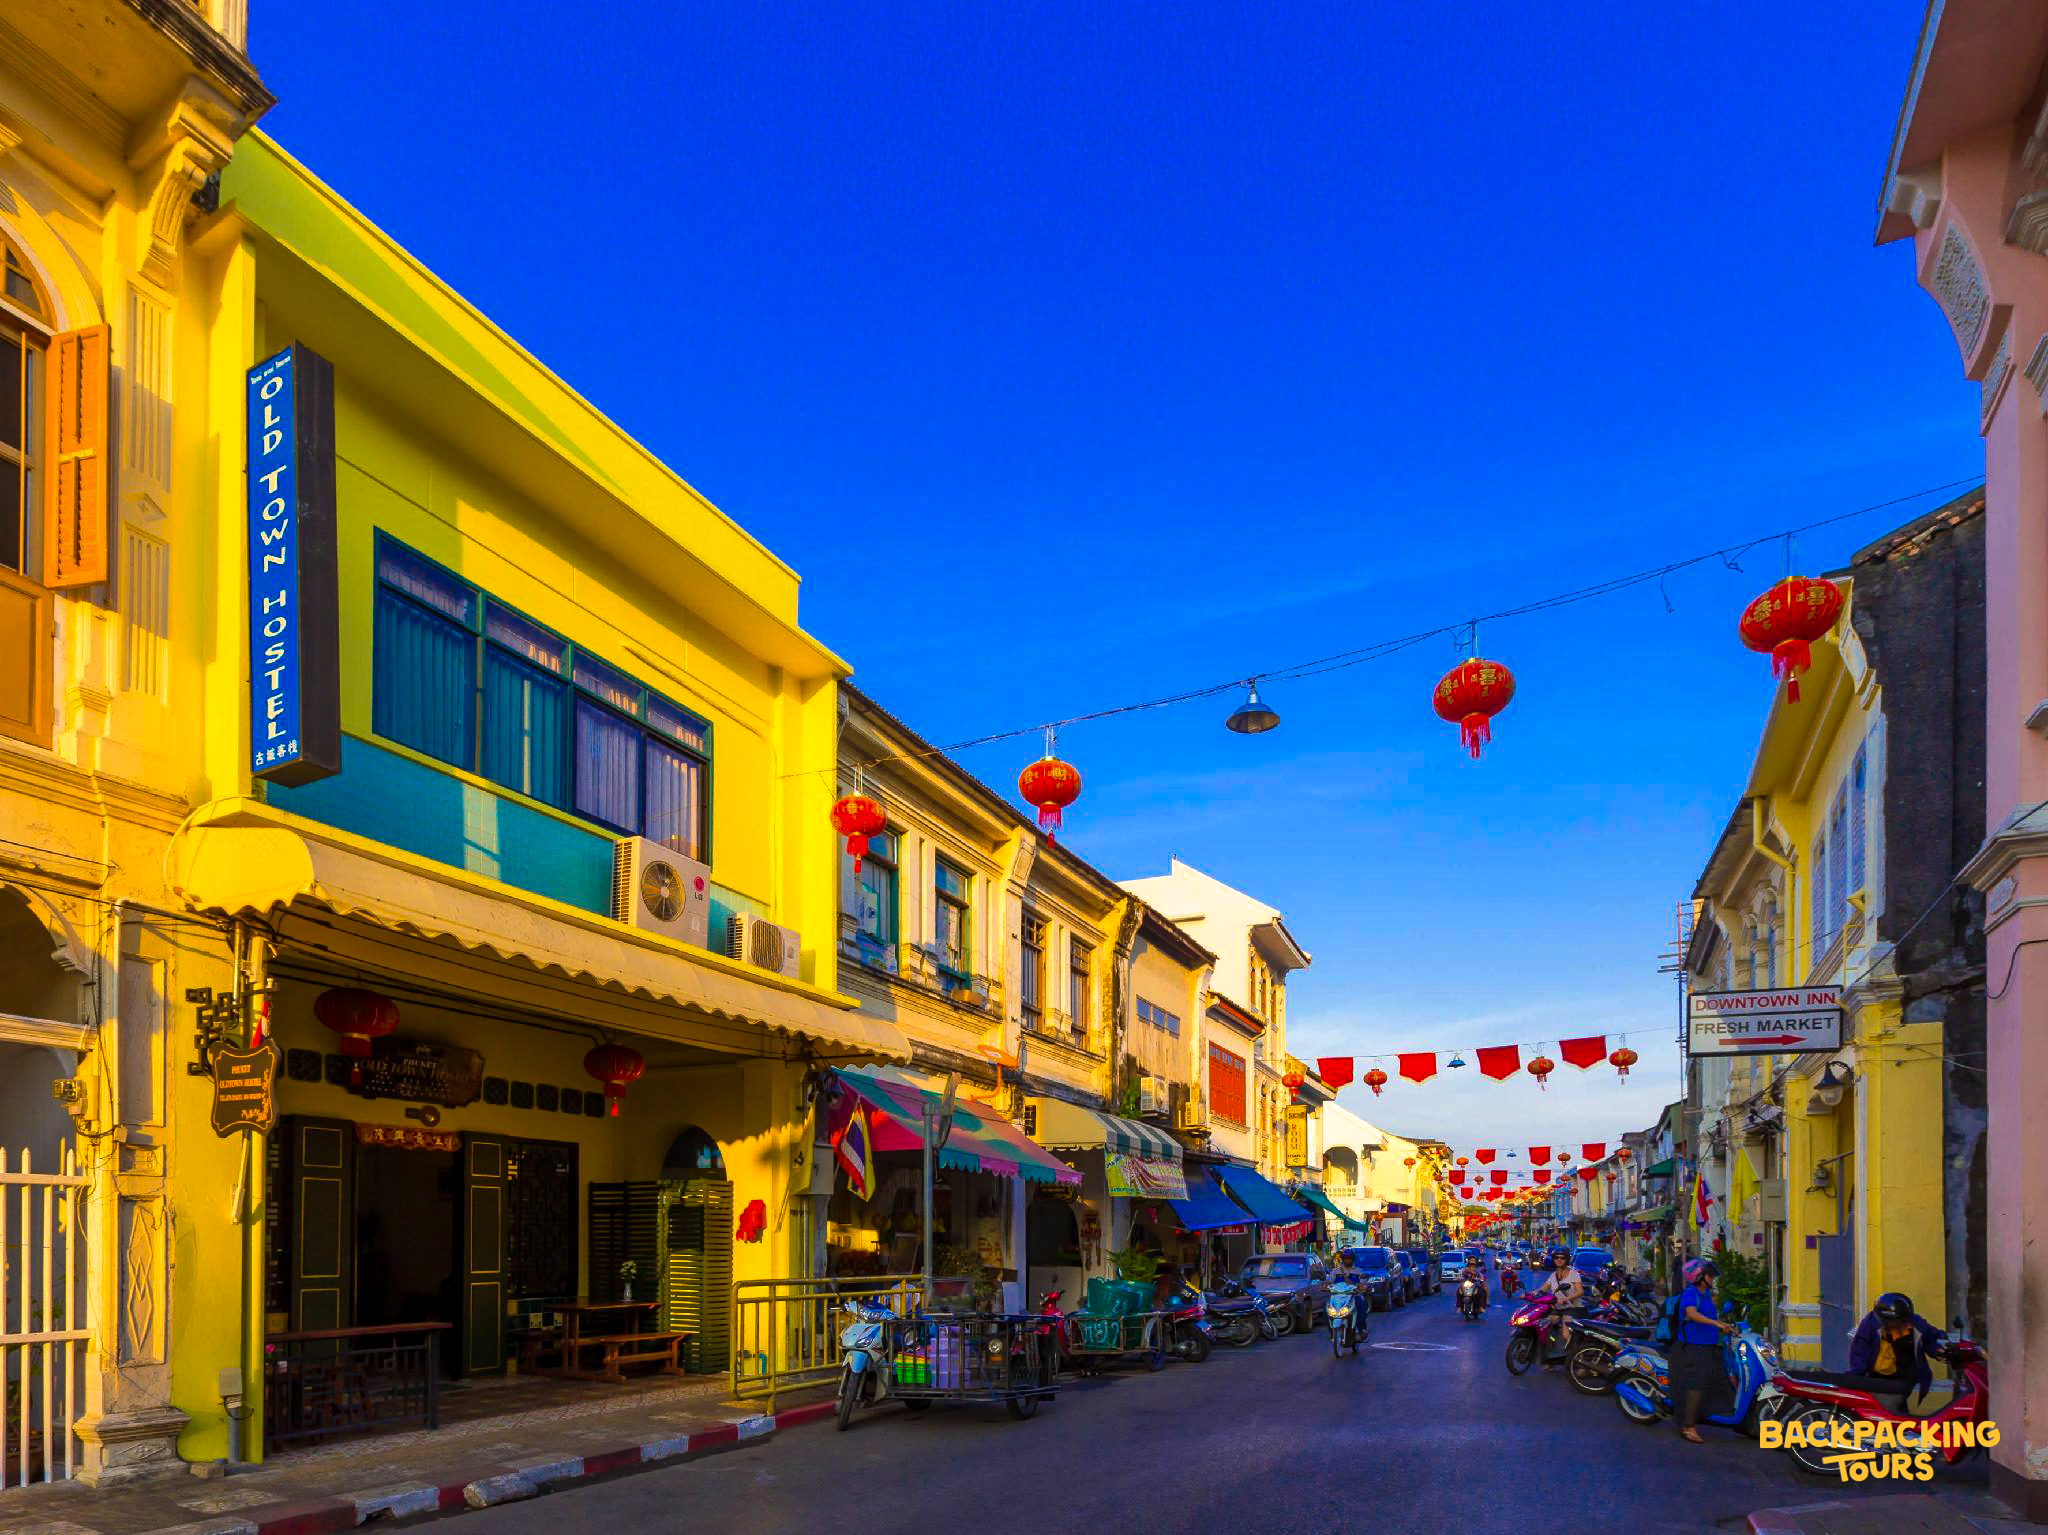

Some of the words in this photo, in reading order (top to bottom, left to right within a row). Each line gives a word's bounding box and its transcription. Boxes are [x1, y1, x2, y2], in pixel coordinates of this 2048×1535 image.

[260, 376, 284, 456] OLD
[259, 464, 288, 573] TOWN
[262, 590, 288, 740] HOSTEL
[1695, 994, 1799, 1012] DOWNTOWN
[1807, 992, 1836, 1005] INN
[1695, 1021, 1749, 1035] FRESH
[1757, 1017, 1834, 1033] MARKET
